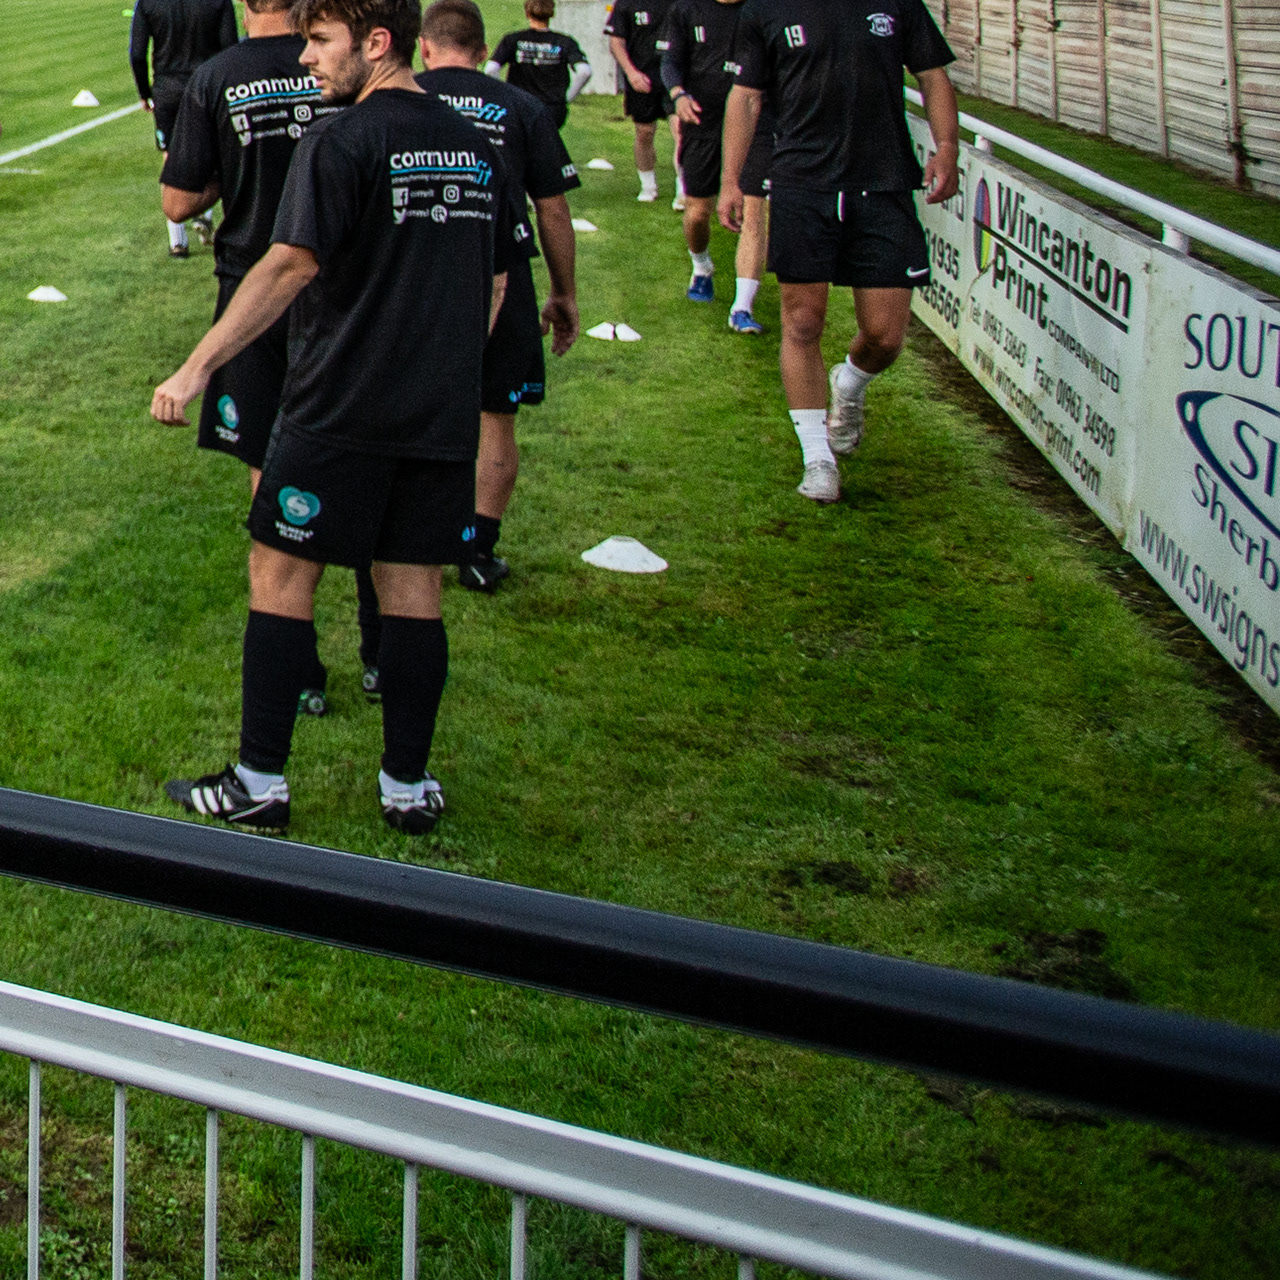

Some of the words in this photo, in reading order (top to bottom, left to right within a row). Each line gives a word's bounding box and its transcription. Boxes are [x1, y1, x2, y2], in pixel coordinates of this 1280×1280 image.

[785, 24, 806, 48] 19
[225, 75, 318, 101] commun
[996, 180, 1132, 320] Wincanton
[918, 278, 960, 329] 26566
[991, 242, 1049, 329] Print
[1100, 362, 1120, 393] LTD
[1056, 377, 1082, 423] 01963
[1082, 403, 1116, 457] 34598
